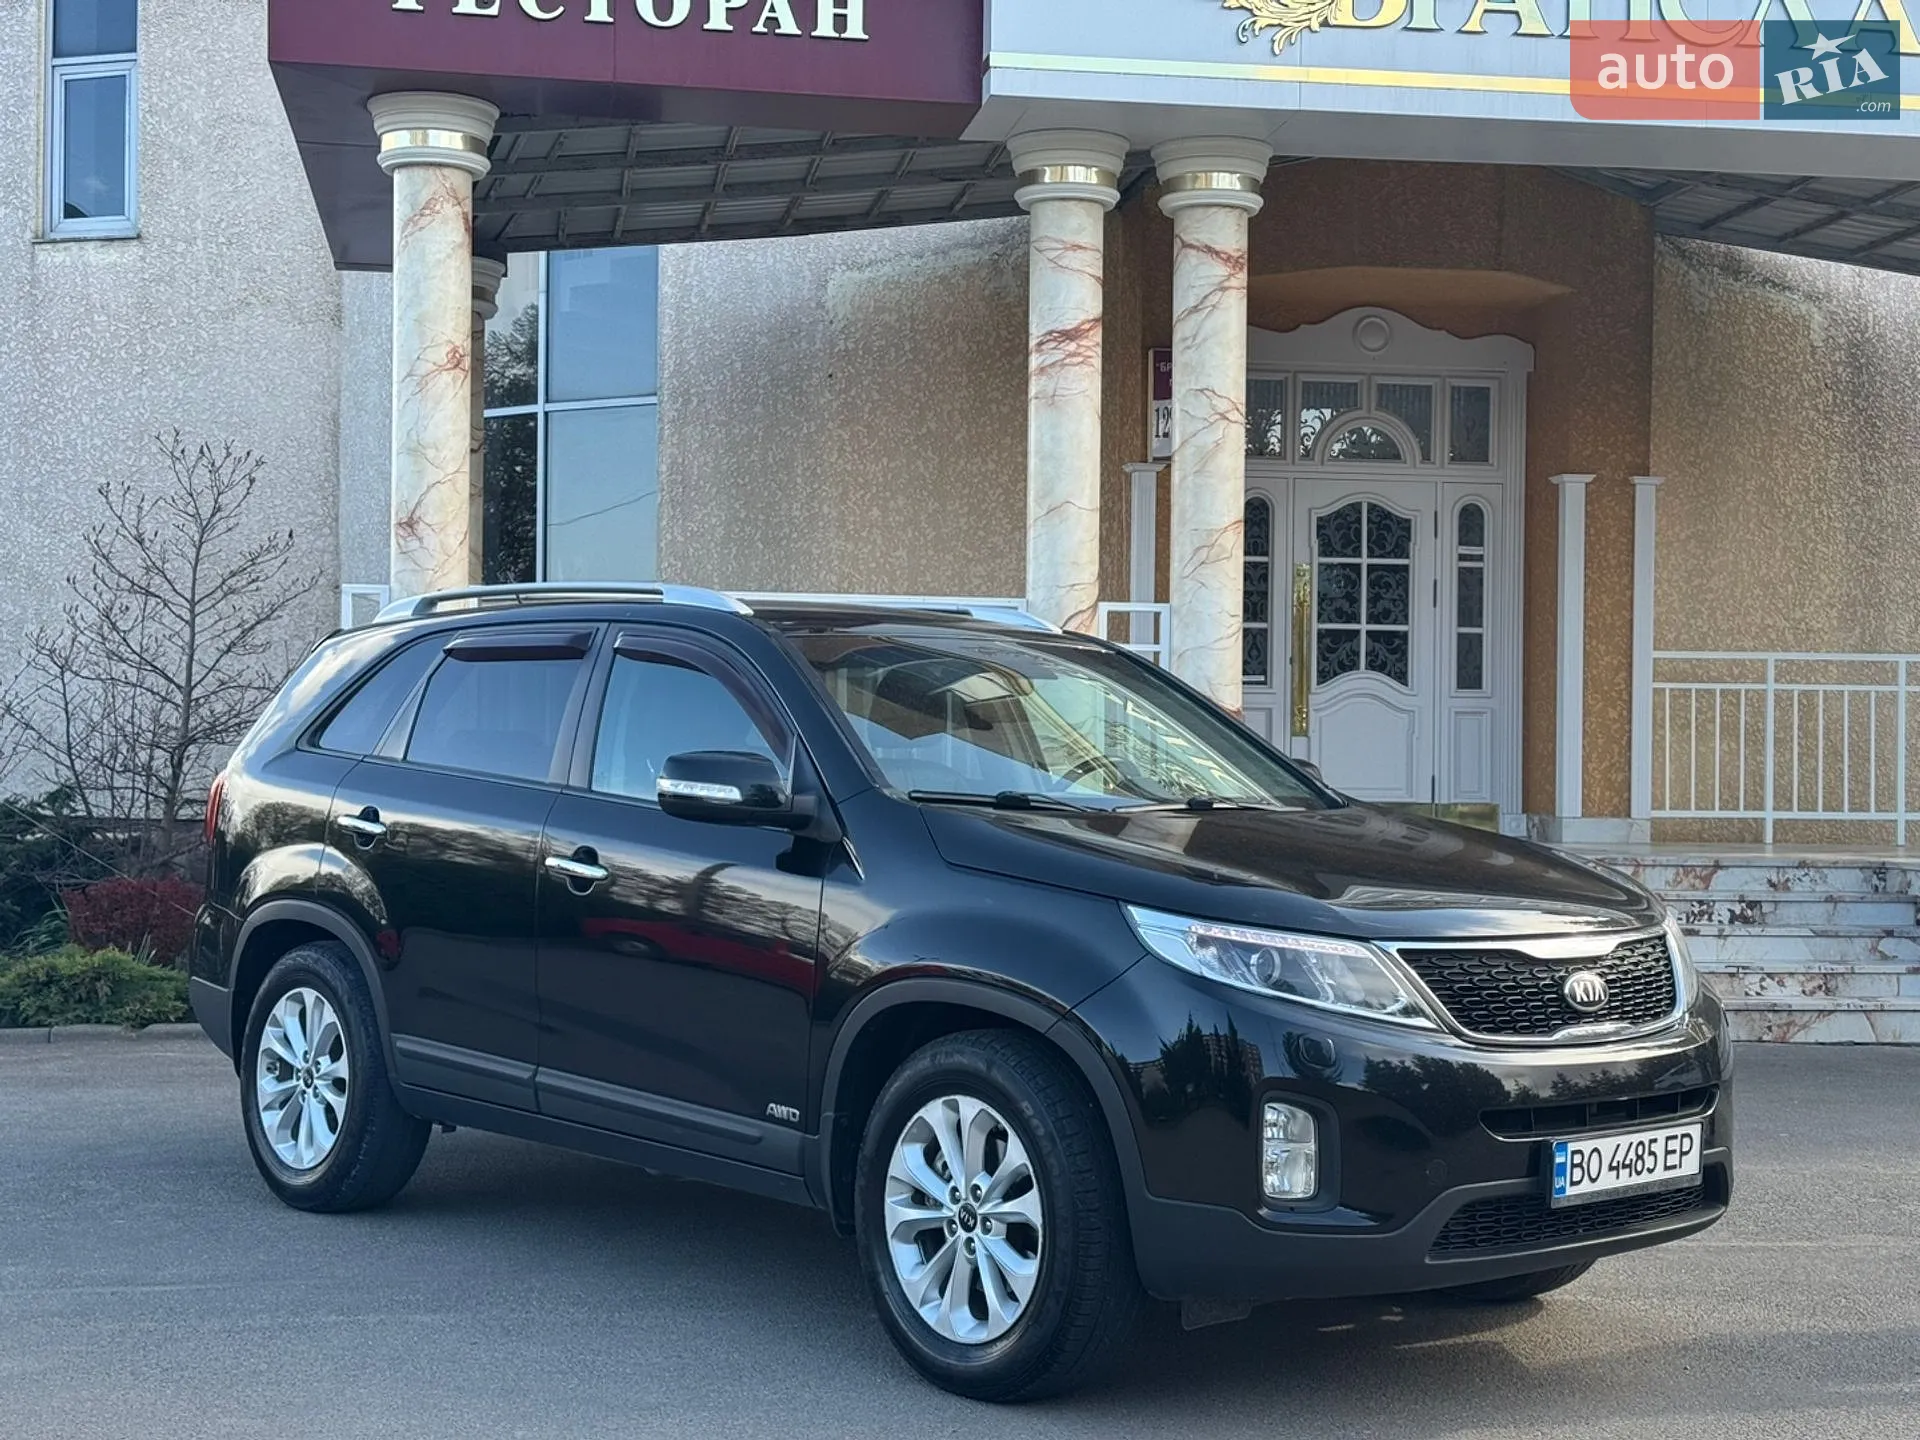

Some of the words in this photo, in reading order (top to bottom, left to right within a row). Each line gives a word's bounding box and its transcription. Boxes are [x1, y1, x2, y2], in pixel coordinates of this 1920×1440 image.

[766, 1102, 800, 1122] AWD
[1569, 1146, 1603, 1187] BO
[1608, 1137, 1658, 1181] 4485
[1663, 1132, 1694, 1172] EP
